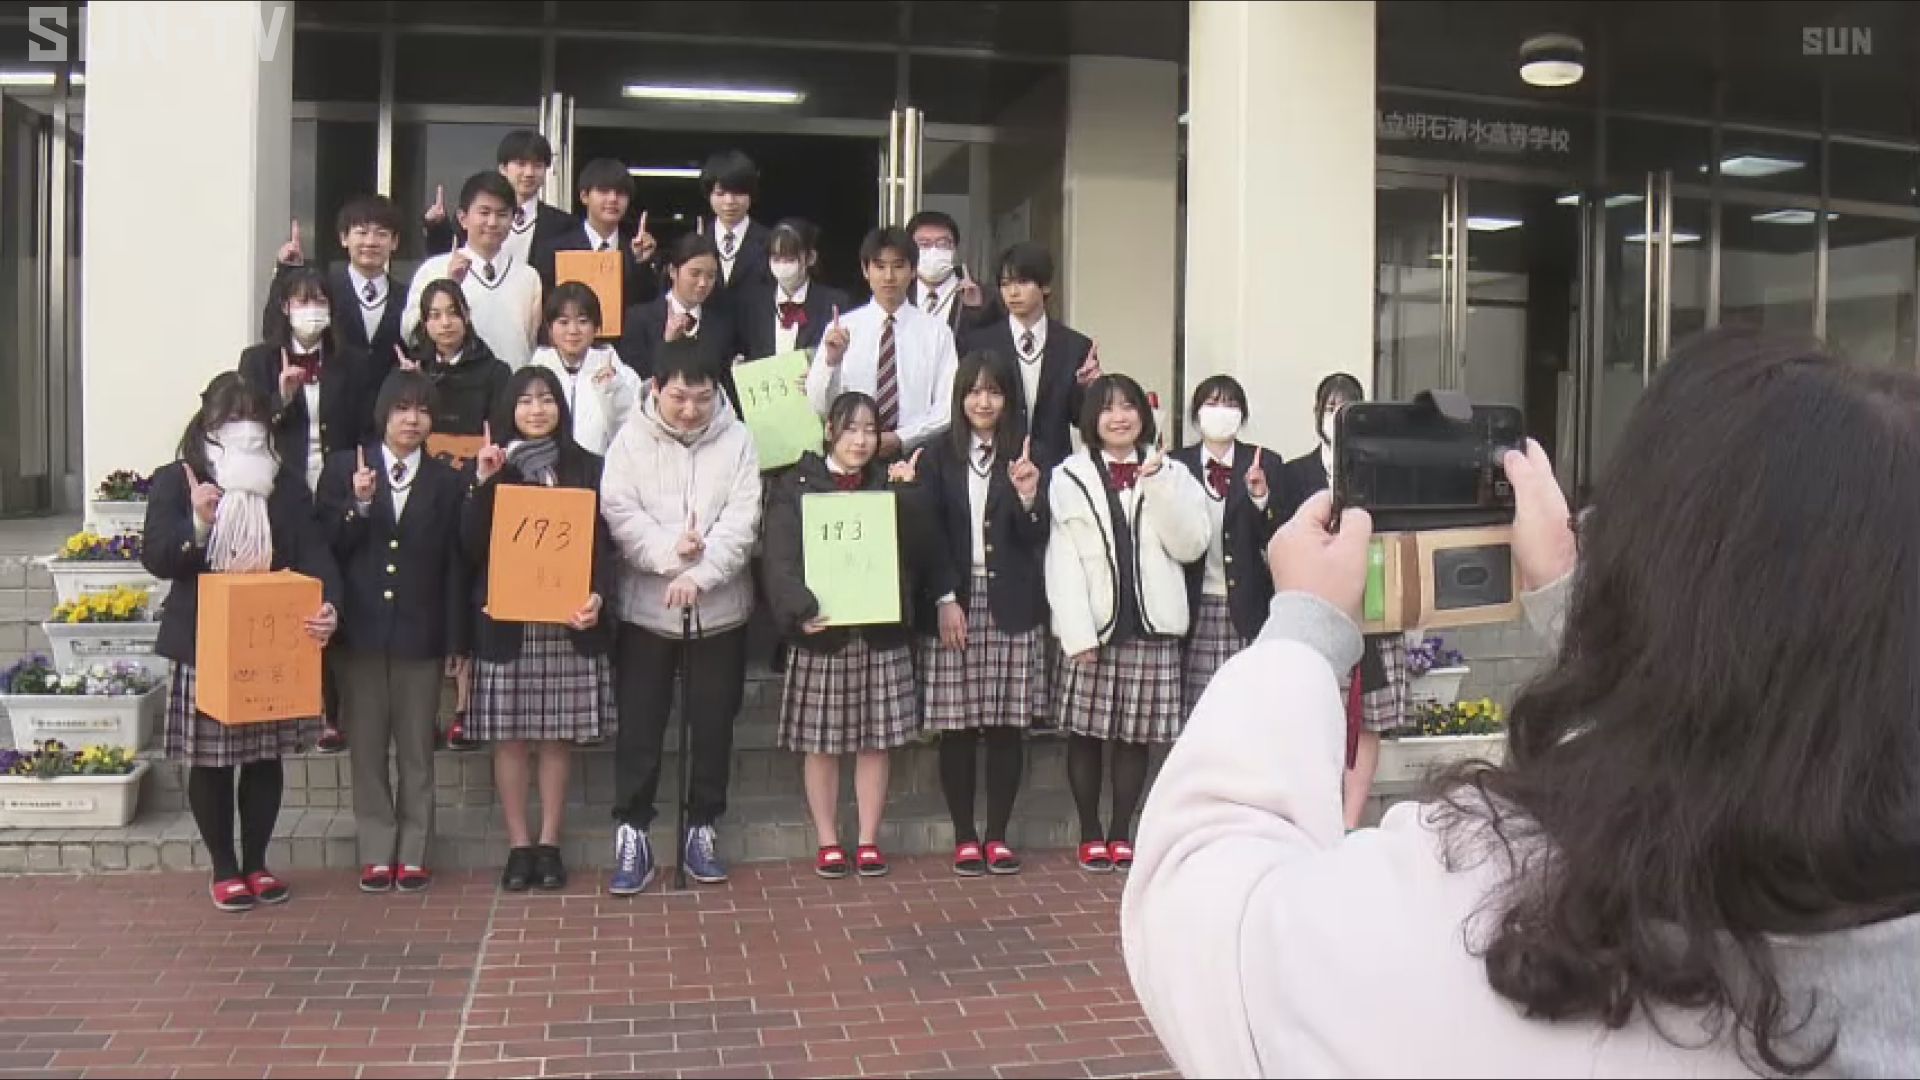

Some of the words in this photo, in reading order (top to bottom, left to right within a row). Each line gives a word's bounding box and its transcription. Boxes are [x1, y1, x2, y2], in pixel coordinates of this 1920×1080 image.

[1376, 110, 1570, 152] 立明石清水高等学校
[512, 516, 572, 551] 193
[820, 520, 862, 541] 193
